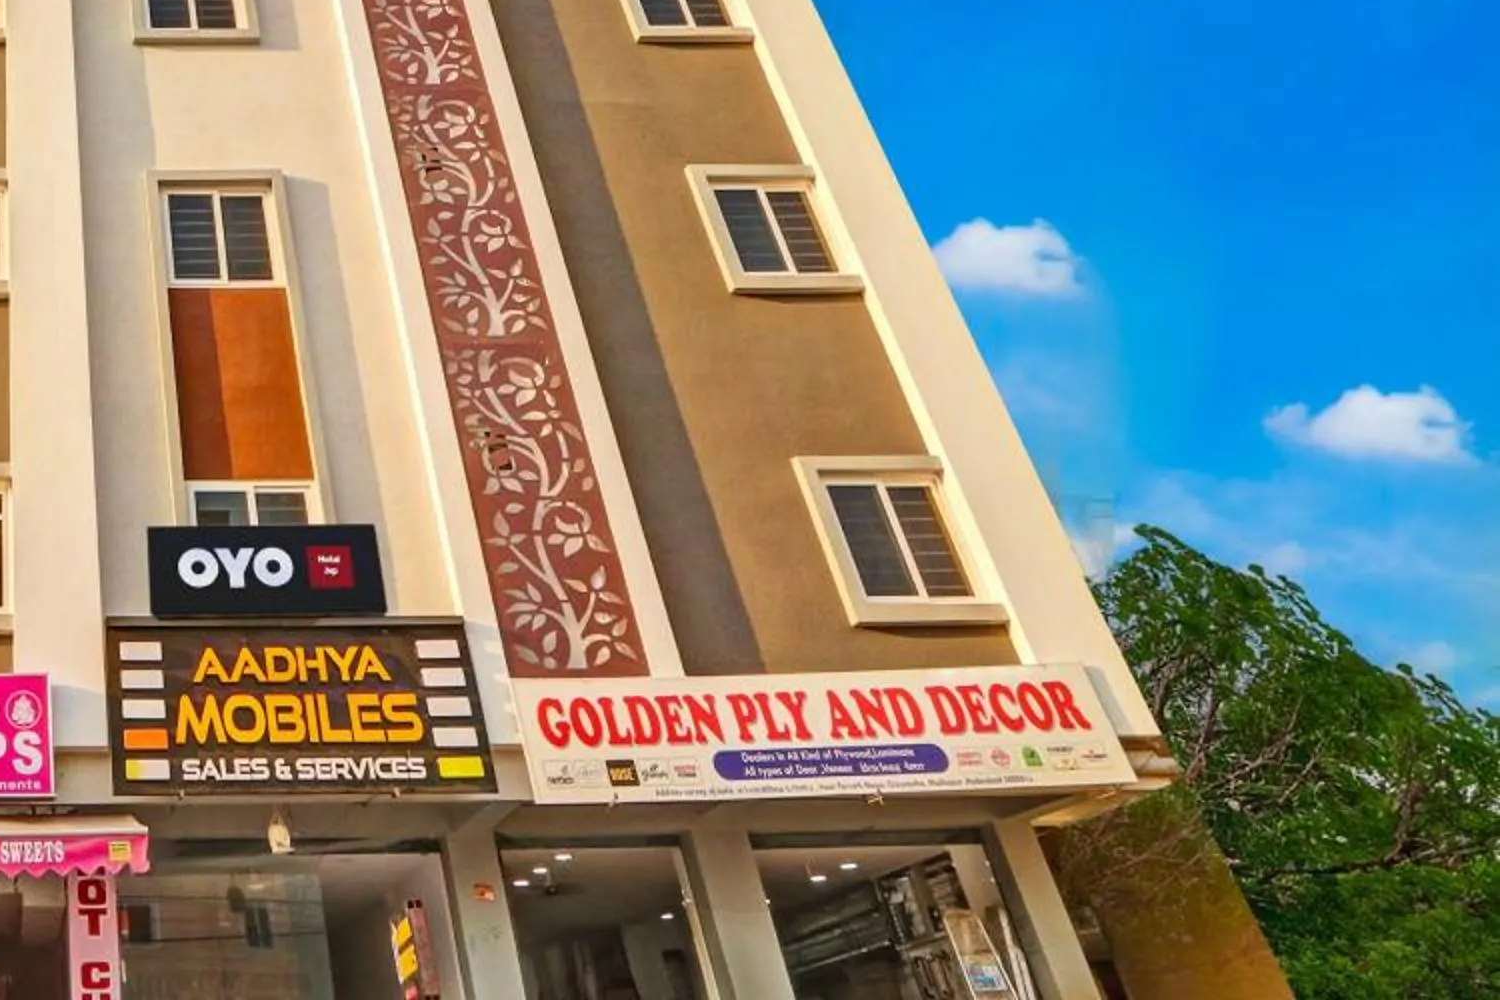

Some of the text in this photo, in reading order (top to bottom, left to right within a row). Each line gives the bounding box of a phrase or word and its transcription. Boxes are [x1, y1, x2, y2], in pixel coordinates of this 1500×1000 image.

[177, 547, 294, 589] OYO
[193, 645, 392, 683] AADHYA
[175, 693, 425, 744] MOBILES
[536, 681, 1092, 748] GOLDEN PLY AND DECOR
[182, 757, 427, 780] SALES & SERVICES
[1, 841, 64, 864] SWEETS
[77, 868, 111, 1000] OT C
